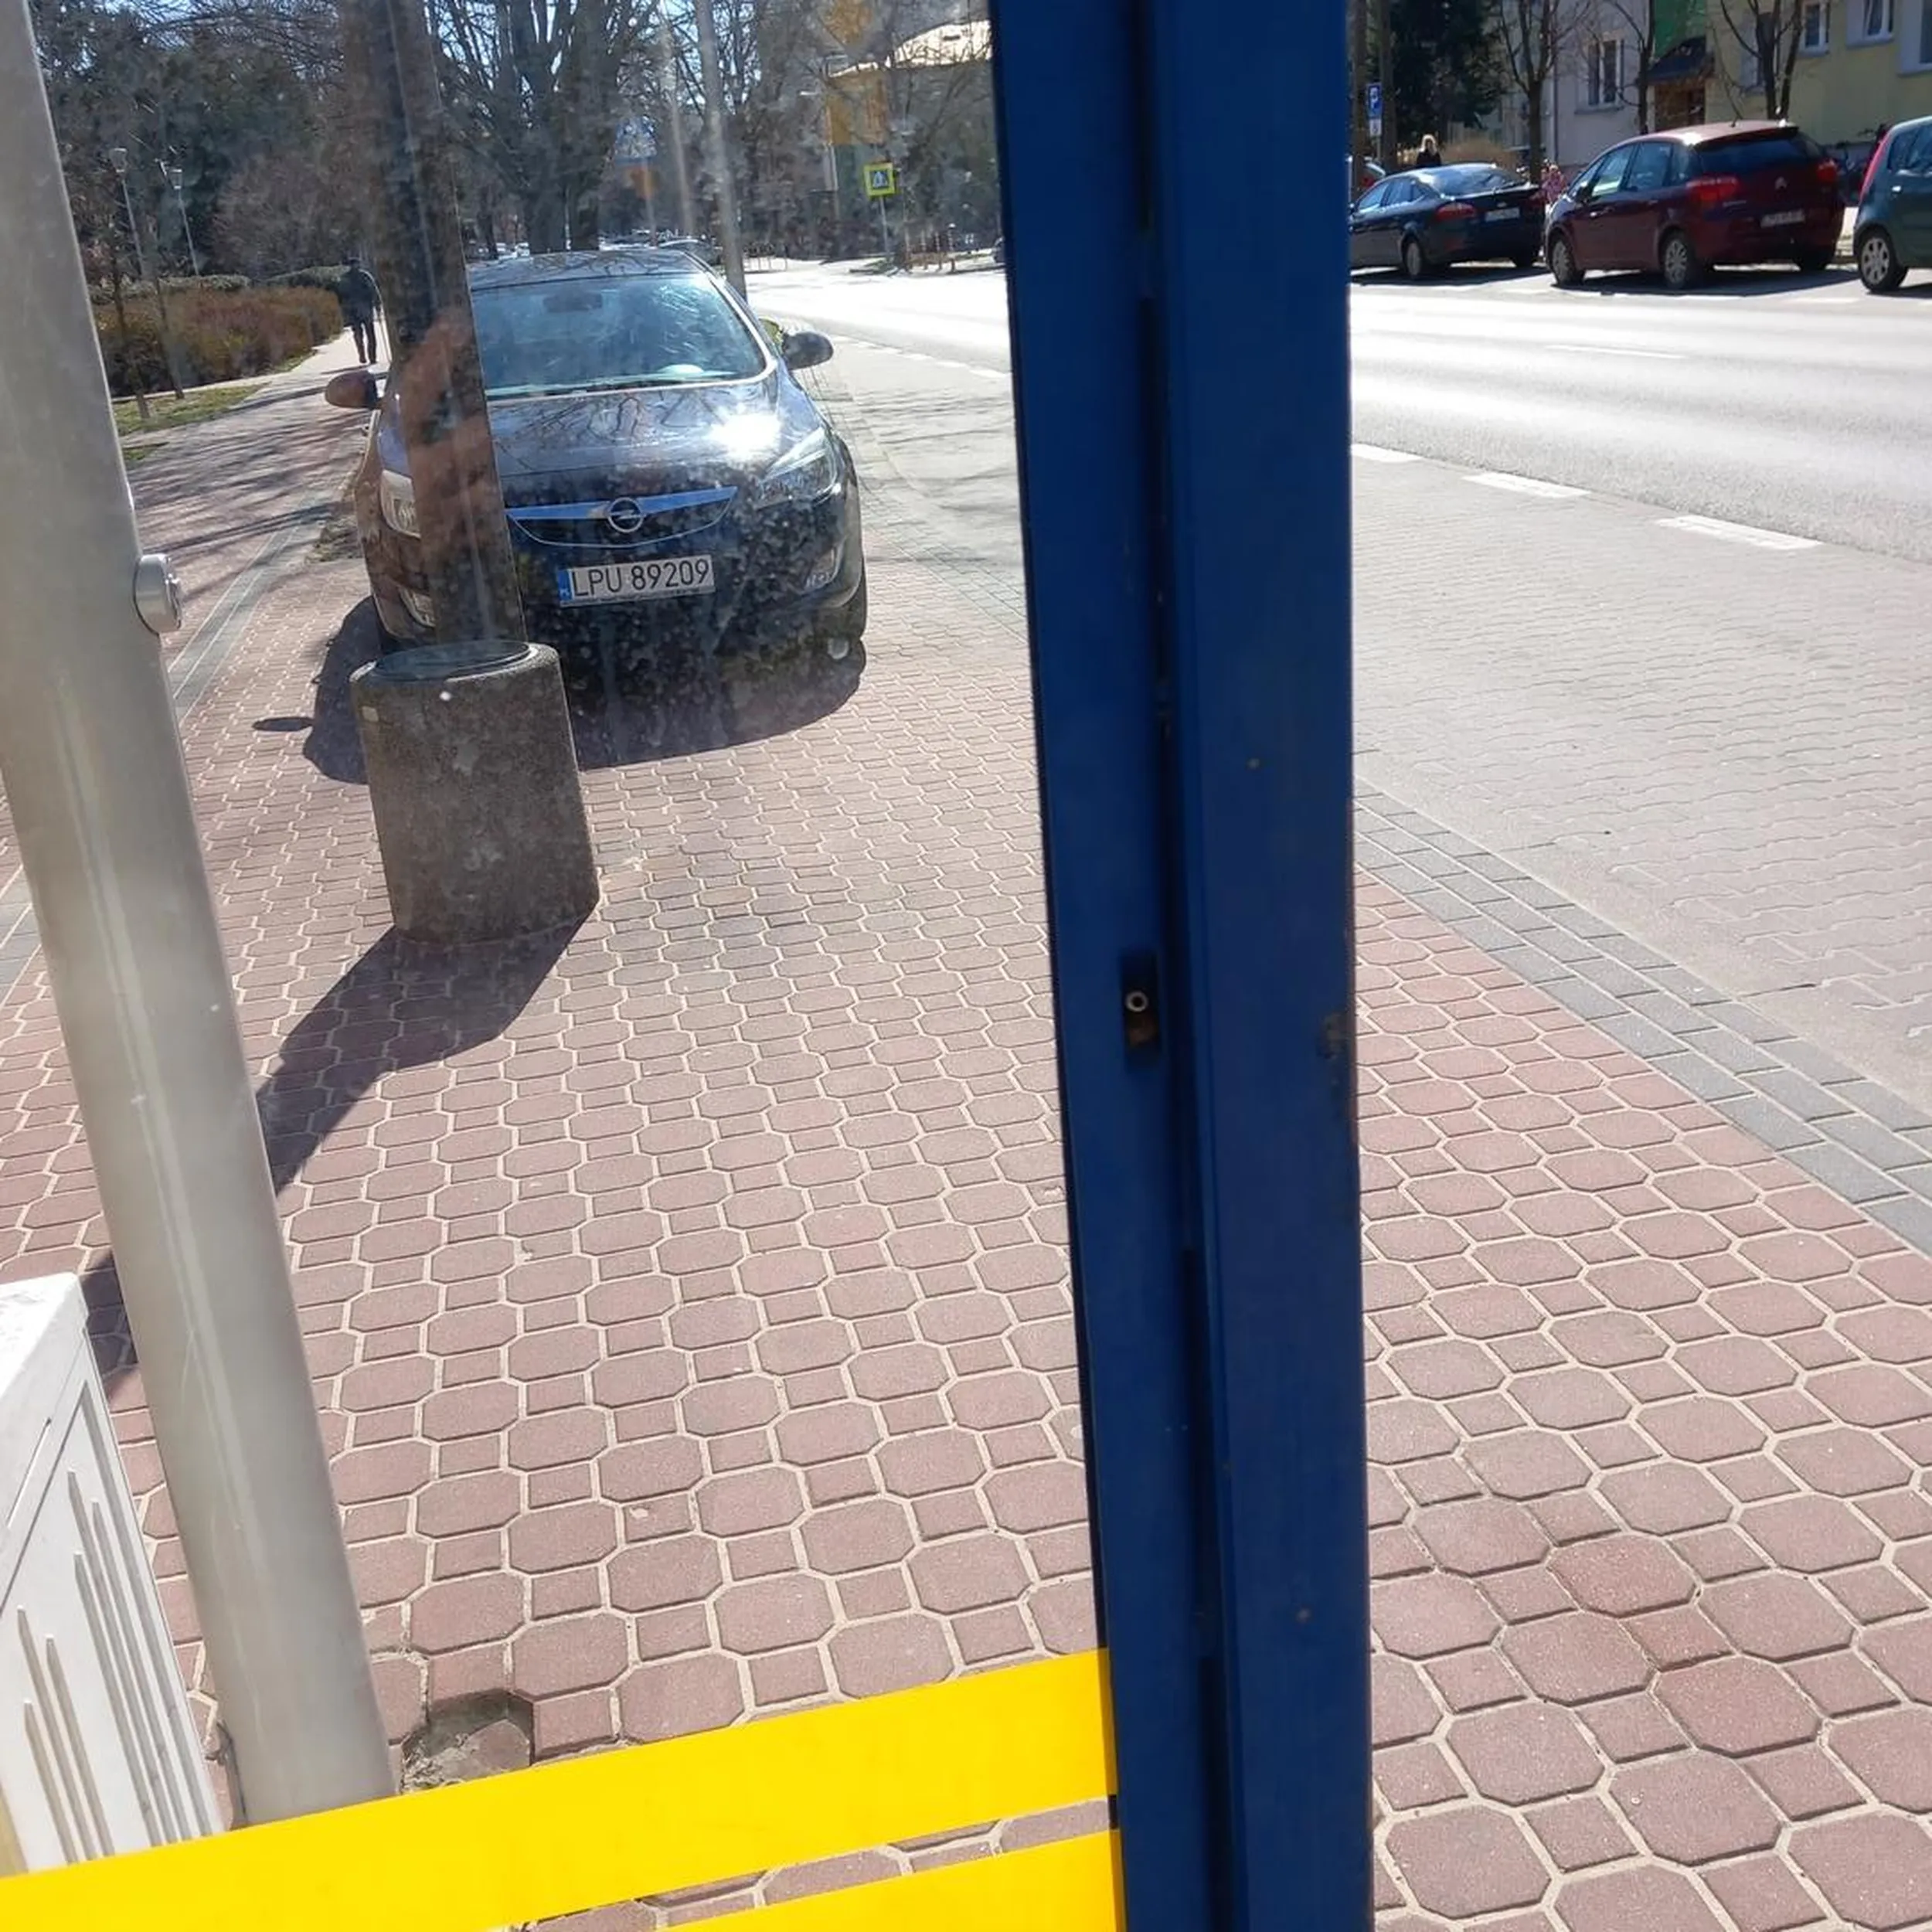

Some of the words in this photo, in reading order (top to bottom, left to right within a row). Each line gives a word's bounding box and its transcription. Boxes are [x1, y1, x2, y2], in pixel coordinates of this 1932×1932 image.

[1369, 87, 1379, 109] P
[572, 568, 622, 597] LPU
[631, 558, 709, 590] 89209
